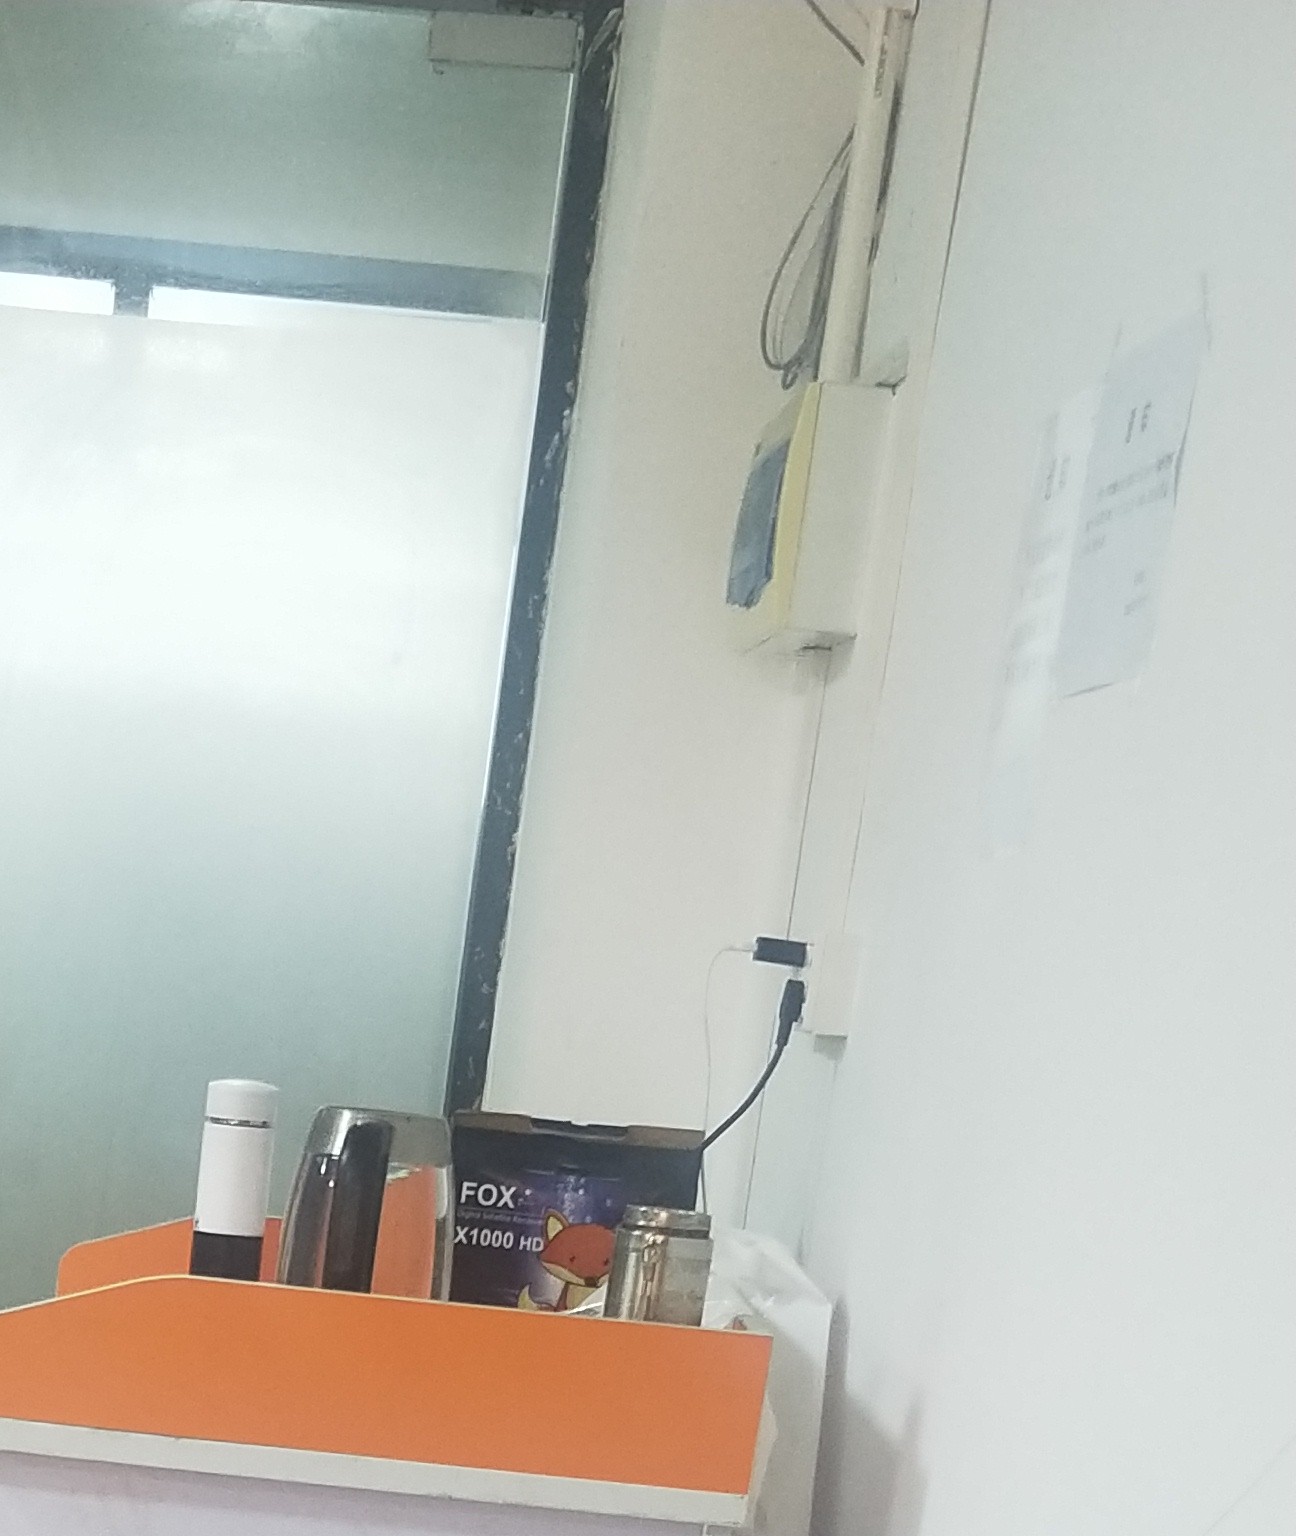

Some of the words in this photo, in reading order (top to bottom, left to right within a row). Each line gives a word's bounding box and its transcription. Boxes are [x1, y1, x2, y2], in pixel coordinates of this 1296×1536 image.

[460, 1181, 517, 1209] FOX
[454, 1225, 514, 1249] X1000
[518, 1235, 544, 1252] HD
